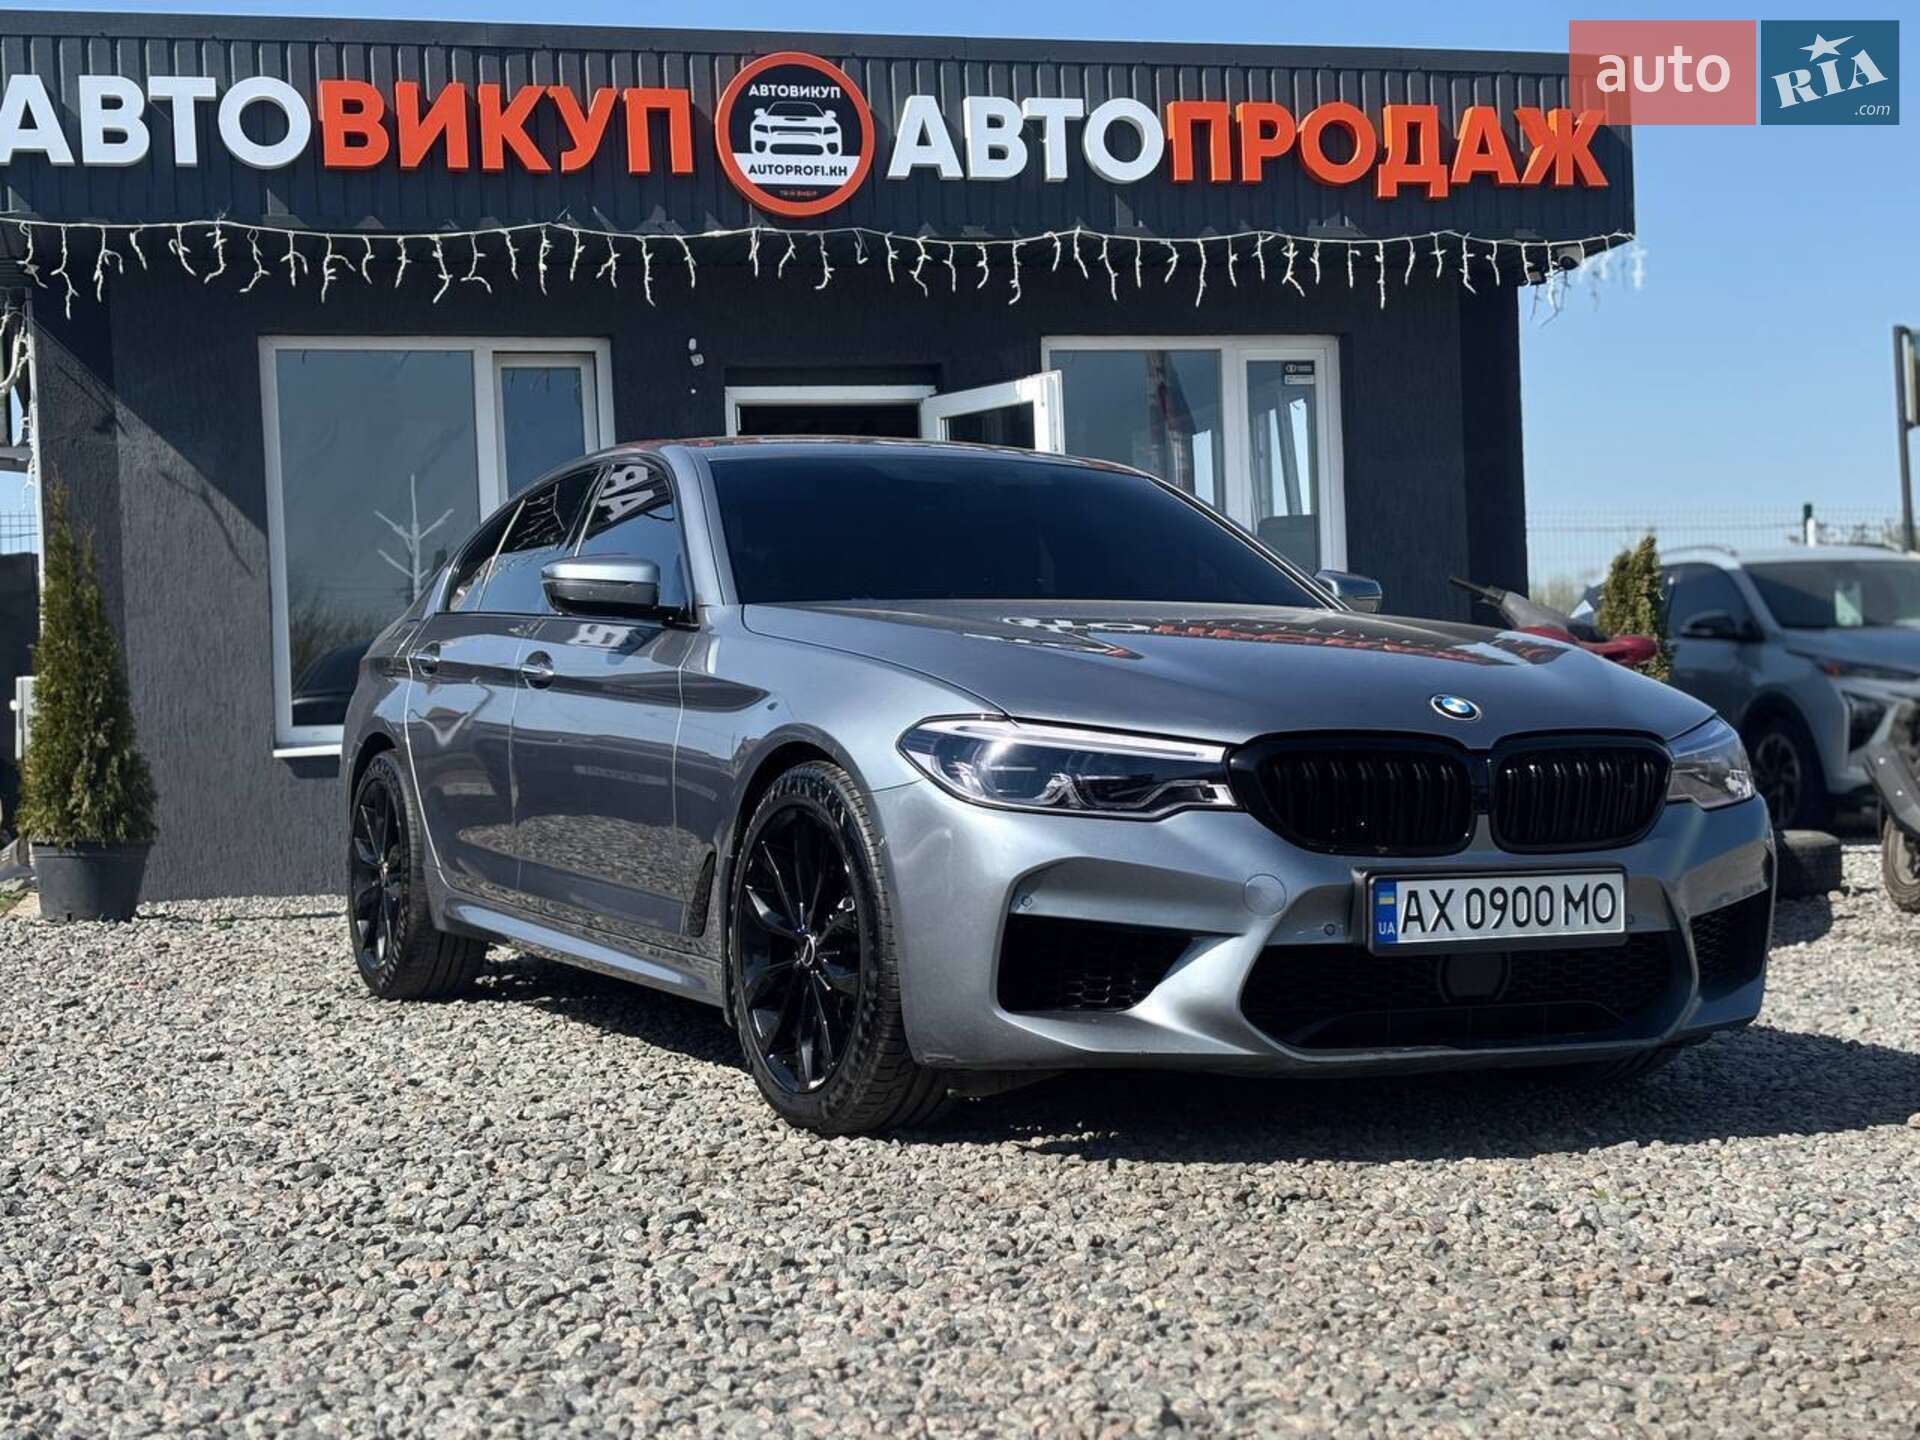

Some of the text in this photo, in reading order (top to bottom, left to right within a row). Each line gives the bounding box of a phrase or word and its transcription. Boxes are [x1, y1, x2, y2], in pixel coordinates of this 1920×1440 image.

[748, 84, 841, 99] АВТОВИКУП
[887, 95, 1609, 199] АВТОПРОДАЖ
[748, 164, 848, 176] AUTOPROFI.KH
[1401, 882, 1617, 934] AX 0900 MO
[1378, 921, 1395, 936] UA
